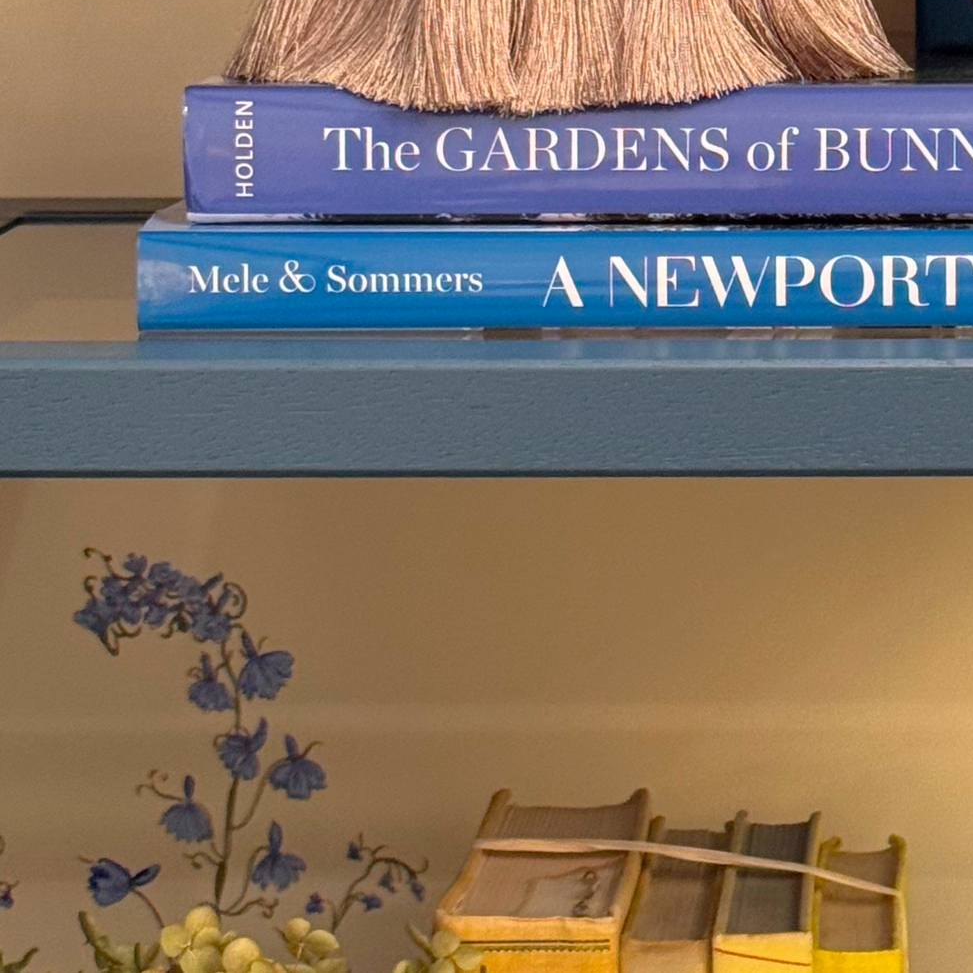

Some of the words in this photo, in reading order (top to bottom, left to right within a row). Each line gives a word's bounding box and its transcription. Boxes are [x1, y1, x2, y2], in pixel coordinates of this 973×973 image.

[234, 100, 255, 197] HOLDEN
[323, 126, 421, 172] The
[435, 126, 731, 173] GARDENS
[746, 126, 800, 173] of
[188, 263, 270, 294] Mele
[279, 260, 317, 294] &
[327, 264, 484, 294] Sommers
[542, 255, 585, 308] A
